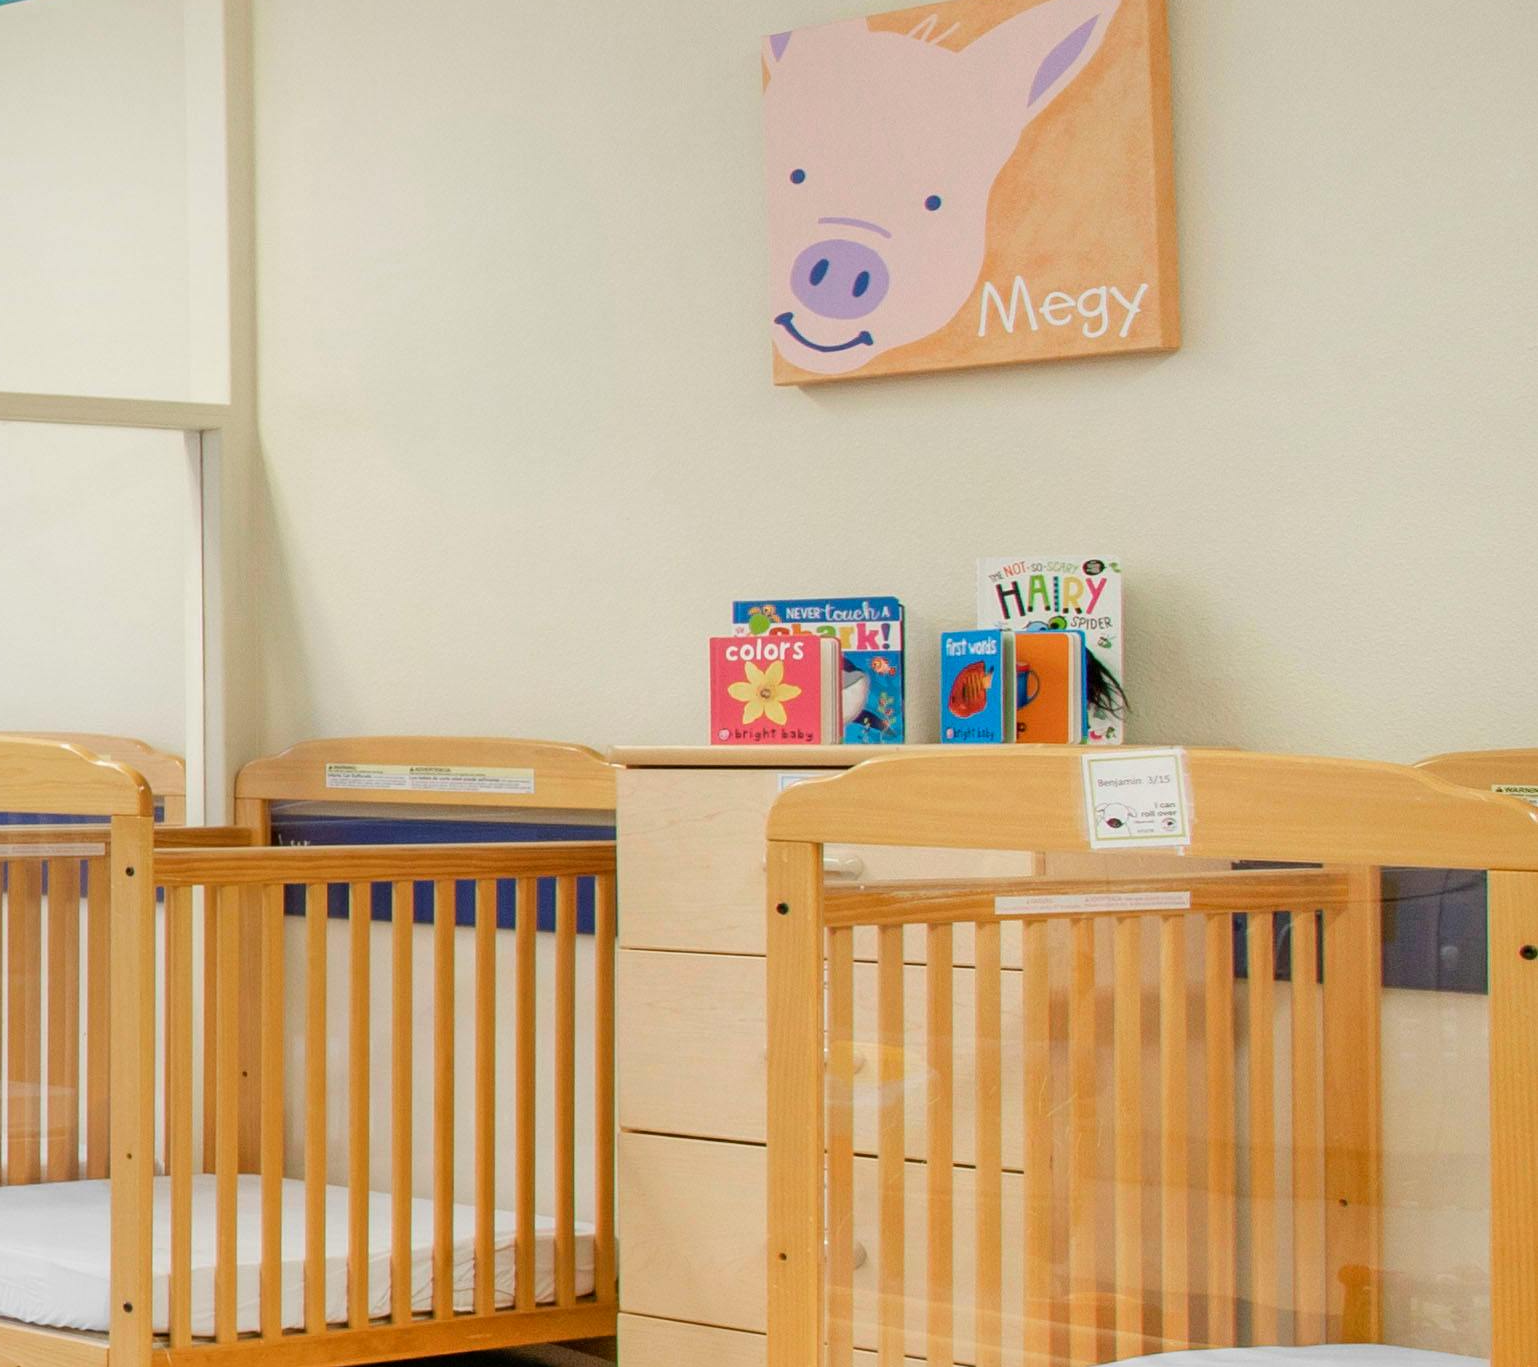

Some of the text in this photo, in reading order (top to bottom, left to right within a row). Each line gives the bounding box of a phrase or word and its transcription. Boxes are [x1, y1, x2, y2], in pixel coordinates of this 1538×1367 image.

[978, 275, 1148, 338] Megy
[995, 574, 1107, 620] HAIRY
[785, 601, 890, 622] NEVER touch A
[1070, 616, 1112, 630] SPIDER
[725, 639, 804, 661] colors
[946, 636, 997, 657] first words
[735, 728, 813, 742] bright baby
[1097, 775, 1170, 787] Benjamin 3/15
